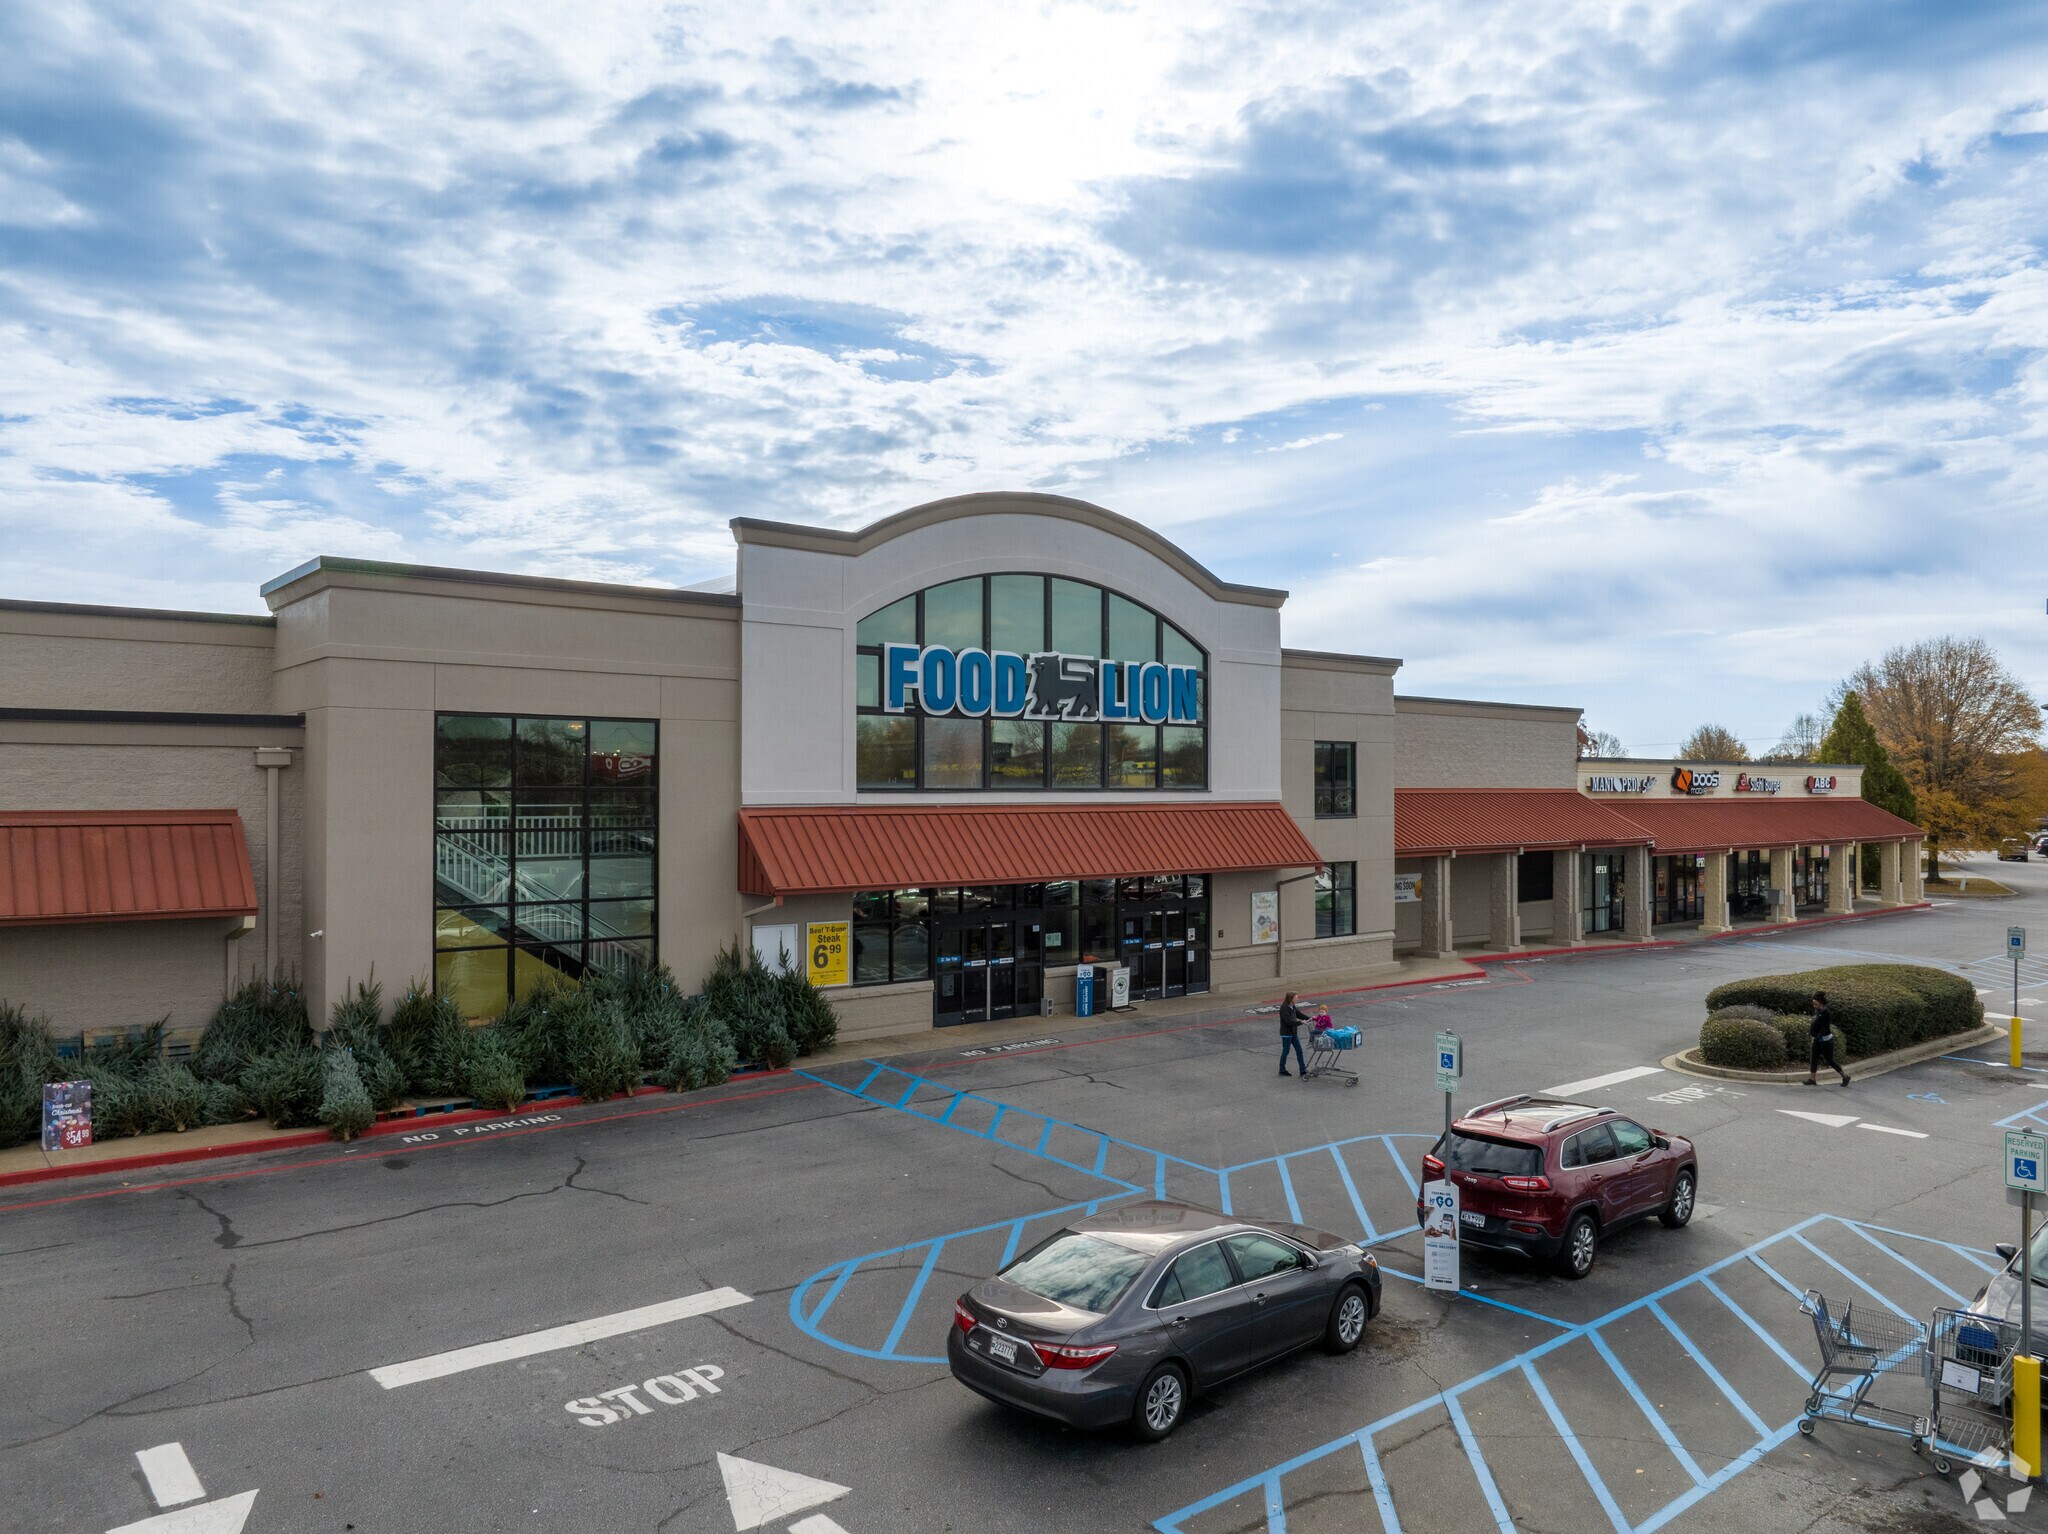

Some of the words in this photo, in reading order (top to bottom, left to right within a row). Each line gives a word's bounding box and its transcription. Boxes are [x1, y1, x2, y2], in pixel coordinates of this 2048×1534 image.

[885, 643, 1025, 717] FOOD
[1099, 659, 1197, 723] LION
[1592, 777, 1614, 792] MANI
[1693, 770, 1721, 787] boost
[1814, 777, 1831, 789] ABC
[817, 934, 841, 943] Steak
[960, 1049, 986, 1057] NO
[990, 1038, 1060, 1052] PARKING
[1646, 1087, 1714, 1104] STOP
[402, 1133, 439, 1144] NO
[453, 1114, 562, 1136] PARKING
[66, 1130, 81, 1144] $54
[2007, 1137, 2044, 1150] RESERVED
[2010, 1148, 2041, 1160] PARKING
[1464, 1176, 1477, 1184] Jeep
[1436, 1195, 1454, 1208] GO
[565, 1364, 725, 1427] STOP
